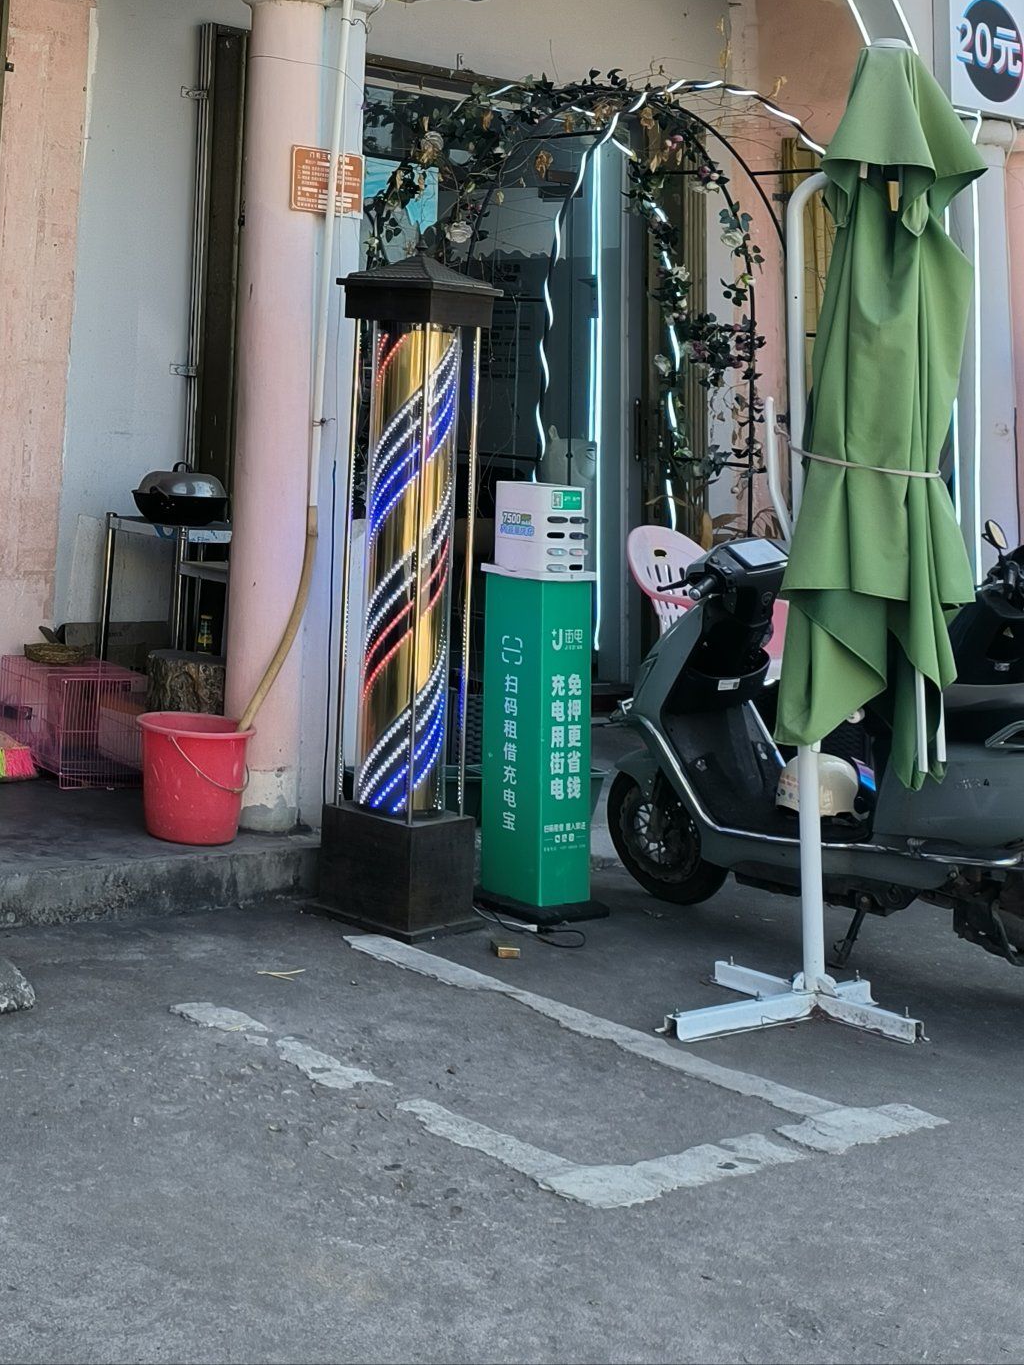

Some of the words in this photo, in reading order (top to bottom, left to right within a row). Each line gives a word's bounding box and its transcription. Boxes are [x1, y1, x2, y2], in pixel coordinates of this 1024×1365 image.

[956, 17, 1023, 77] 20元
[502, 511, 521, 525] 7500
[502, 673, 518, 832] 扫码租借充电宝
[550, 674, 566, 801] 充电用街电
[566, 673, 582, 799] 免押更省钱
